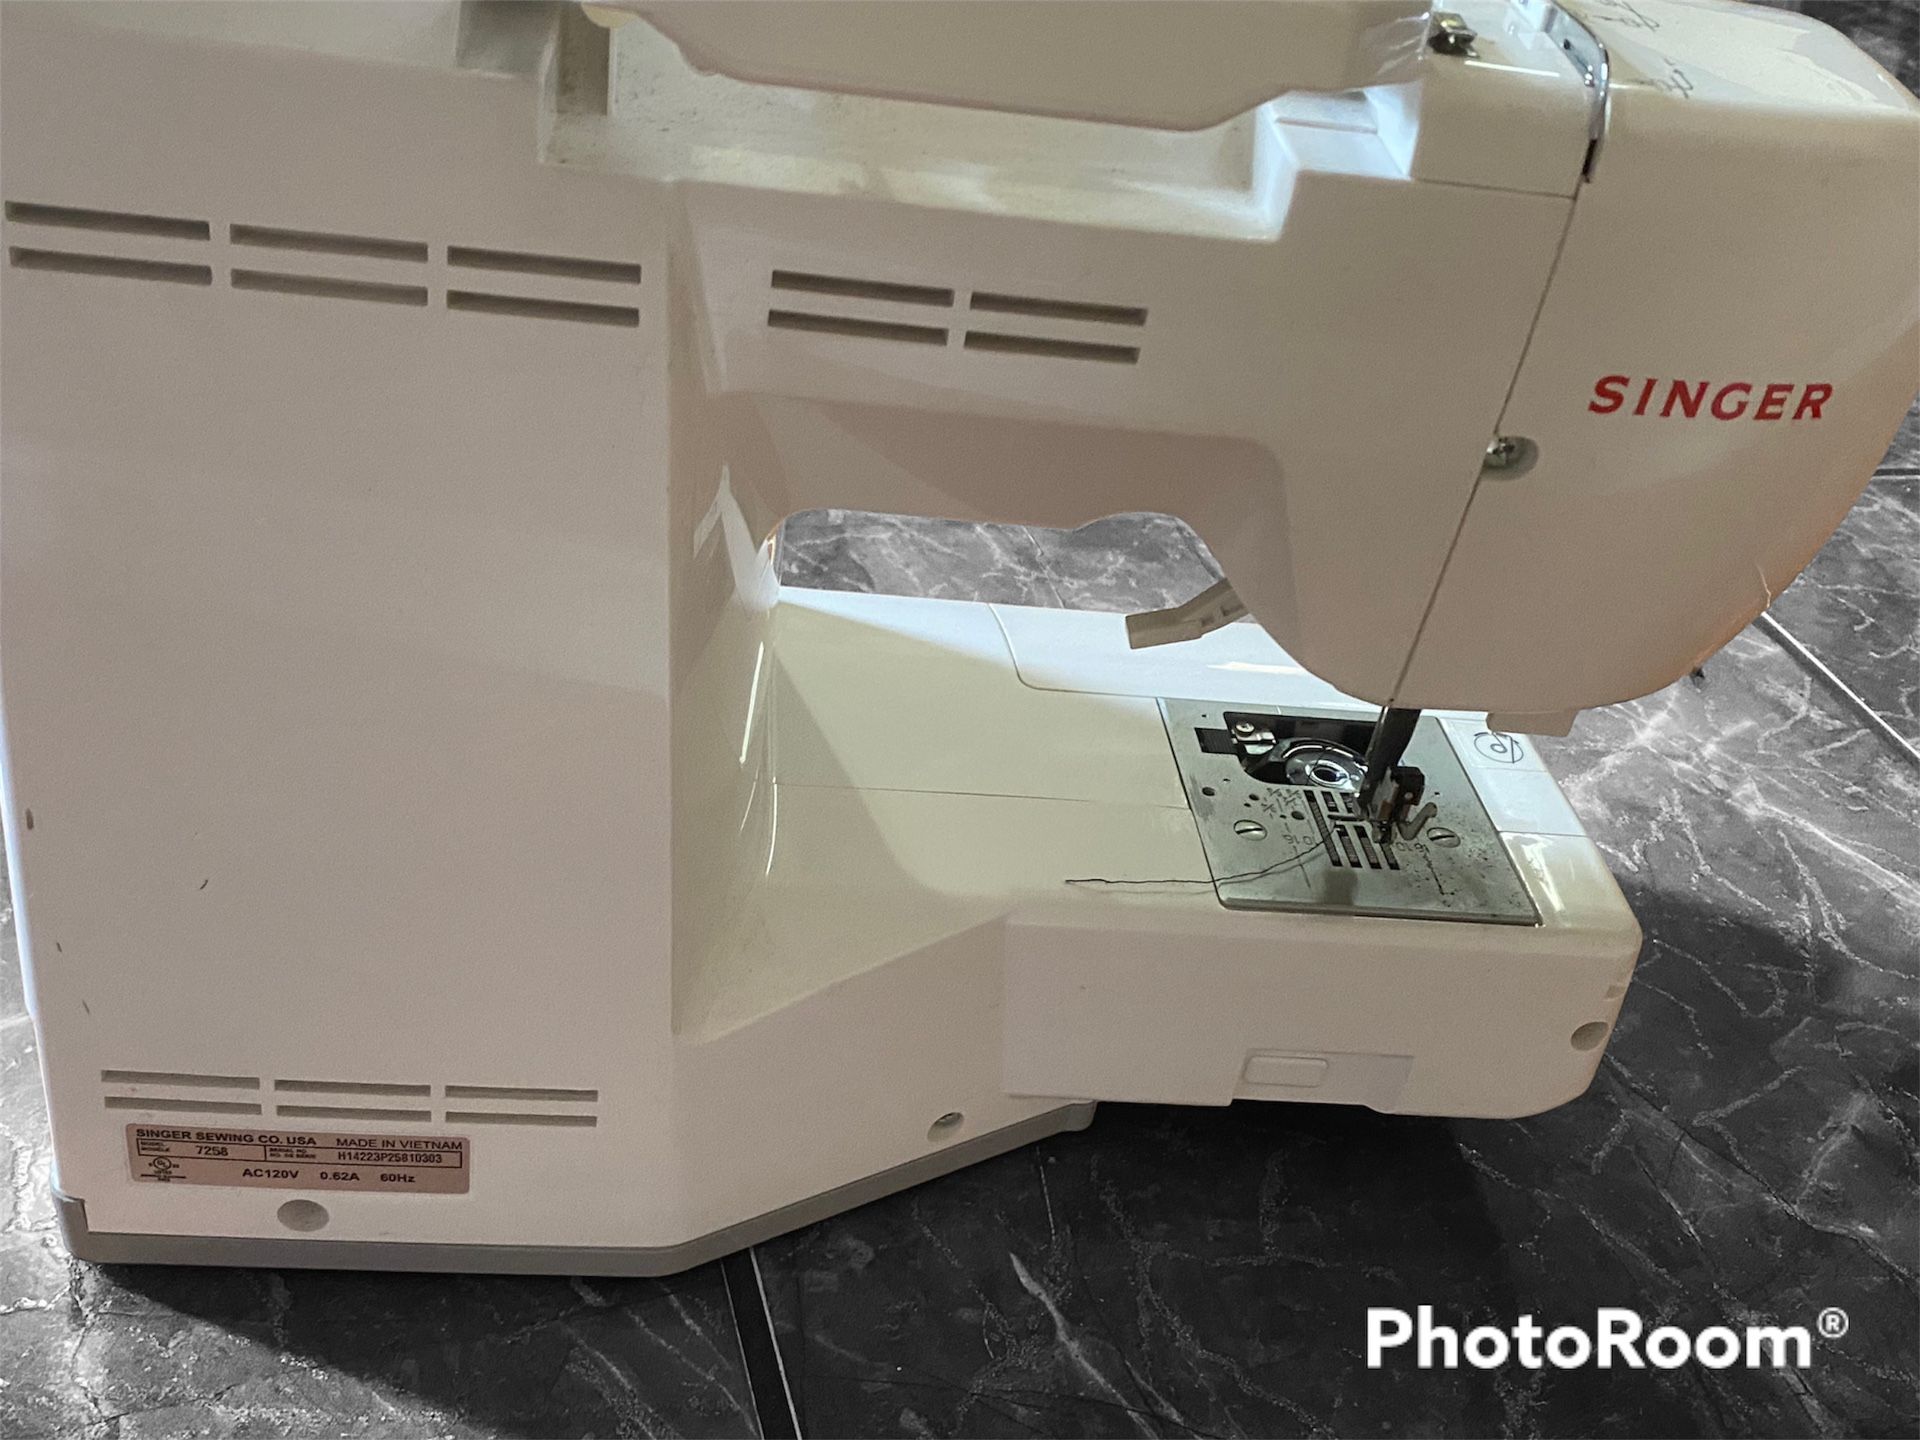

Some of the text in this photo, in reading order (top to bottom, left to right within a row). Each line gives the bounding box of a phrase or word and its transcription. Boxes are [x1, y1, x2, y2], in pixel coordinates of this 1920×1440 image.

[1588, 375, 1833, 421] SINGER
[136, 1128, 317, 1146] SINGER SEWING CO. USA
[336, 1138, 463, 1150] MADE IN VIETNAM
[195, 1145, 229, 1156] 7258
[242, 1168, 299, 1180] AC120V
[320, 1171, 360, 1181] 0.62A
[380, 1173, 416, 1183] 60Hz
